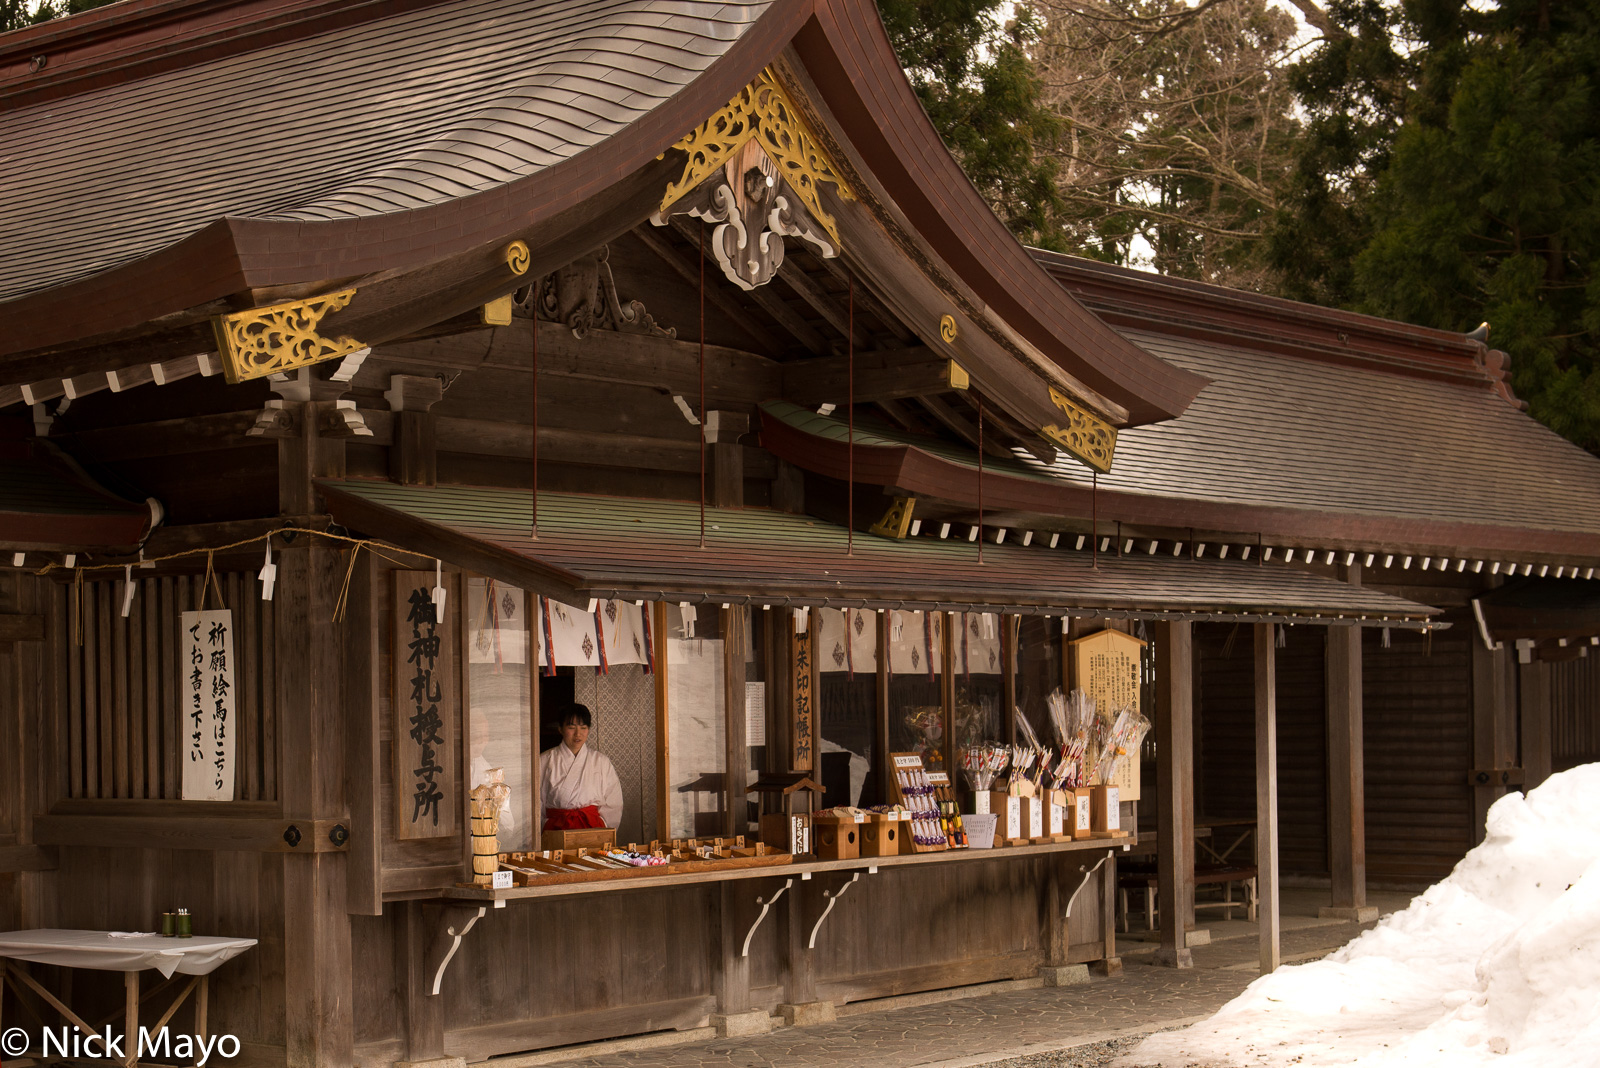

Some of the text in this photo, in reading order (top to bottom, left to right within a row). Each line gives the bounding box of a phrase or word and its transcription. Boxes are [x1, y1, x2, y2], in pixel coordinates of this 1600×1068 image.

[189, 620, 204, 762] でお書き下さい
[208, 621, 230, 790] 祈願絵馬はこちら
[406, 586, 444, 827] 御神札授与所
[793, 628, 811, 762] 御朱印記帳所
